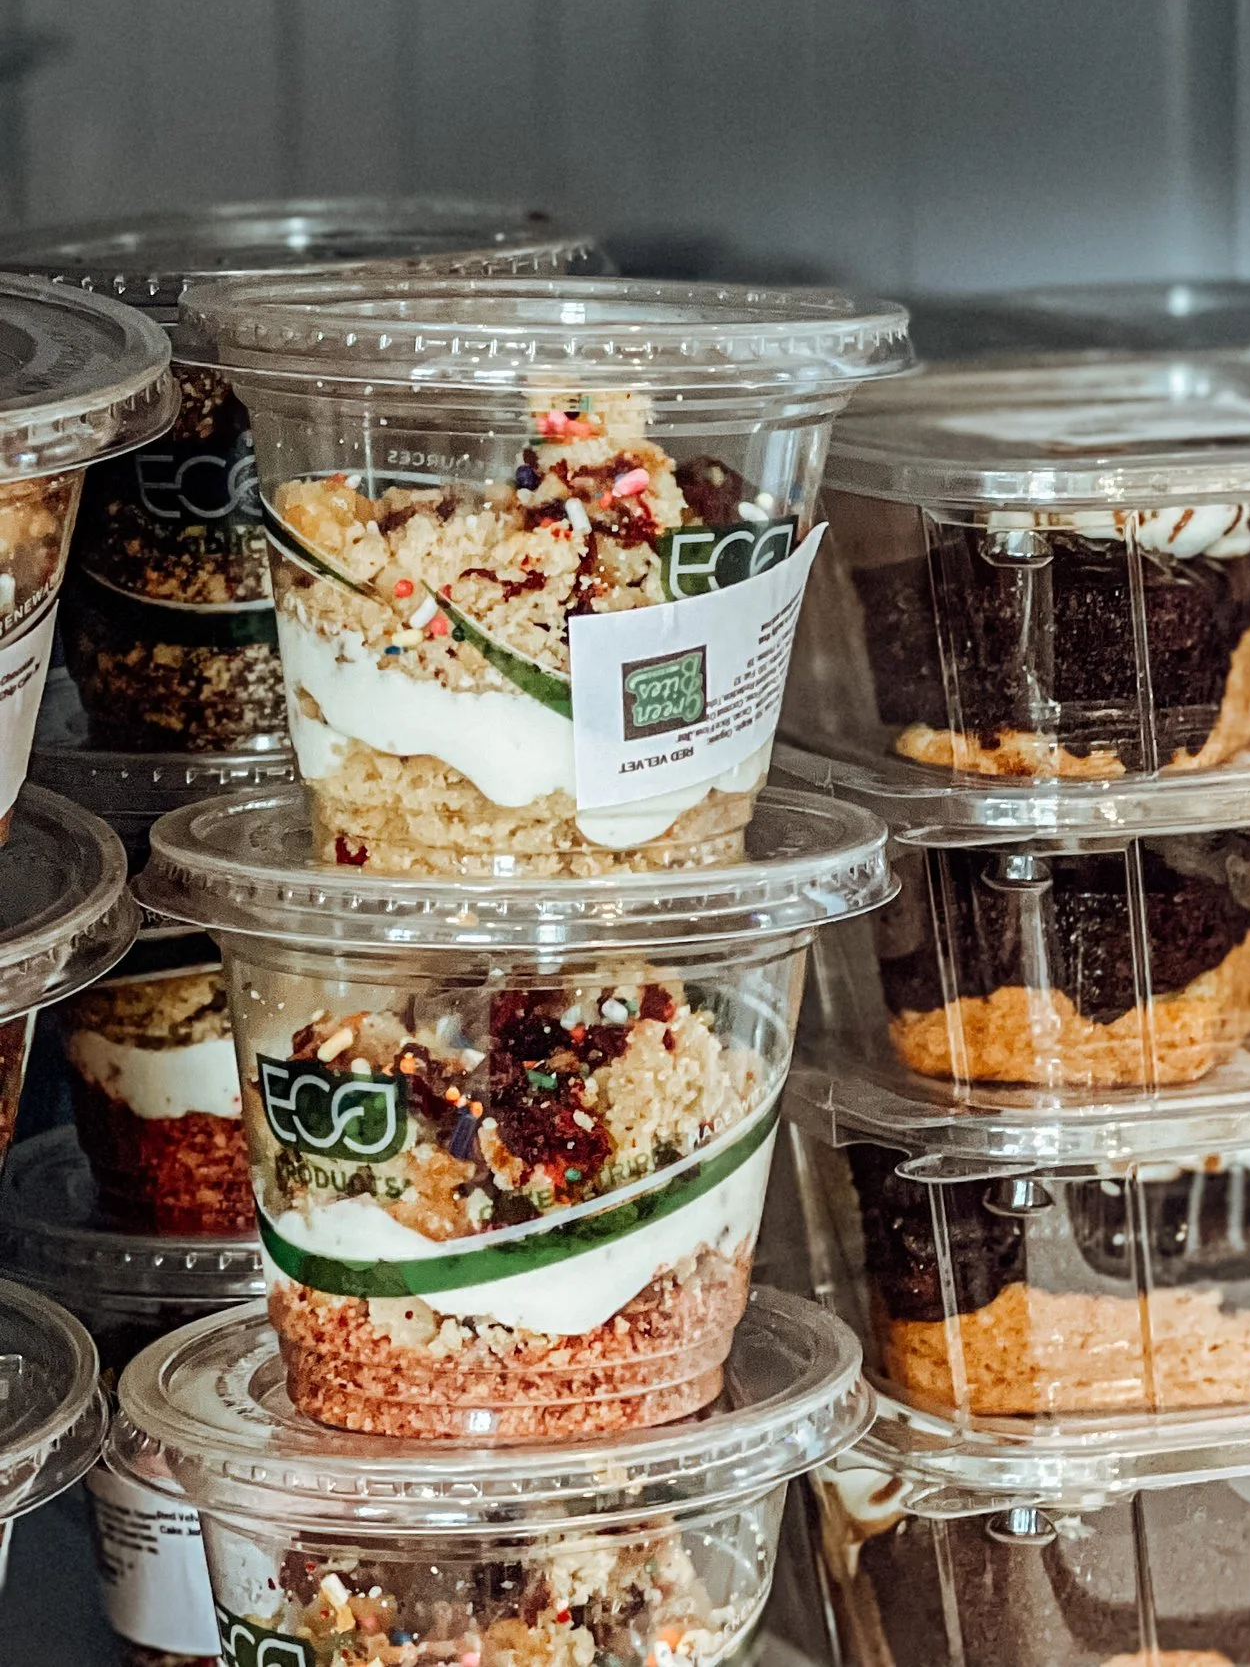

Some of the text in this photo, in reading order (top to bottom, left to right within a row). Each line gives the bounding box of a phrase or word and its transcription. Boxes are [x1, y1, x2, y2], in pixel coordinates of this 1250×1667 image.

[638, 656, 702, 700] Bites
[636, 694, 702, 723] Green
[619, 746, 694, 774] RED VELVET
[262, 1063, 397, 1155] ECO
